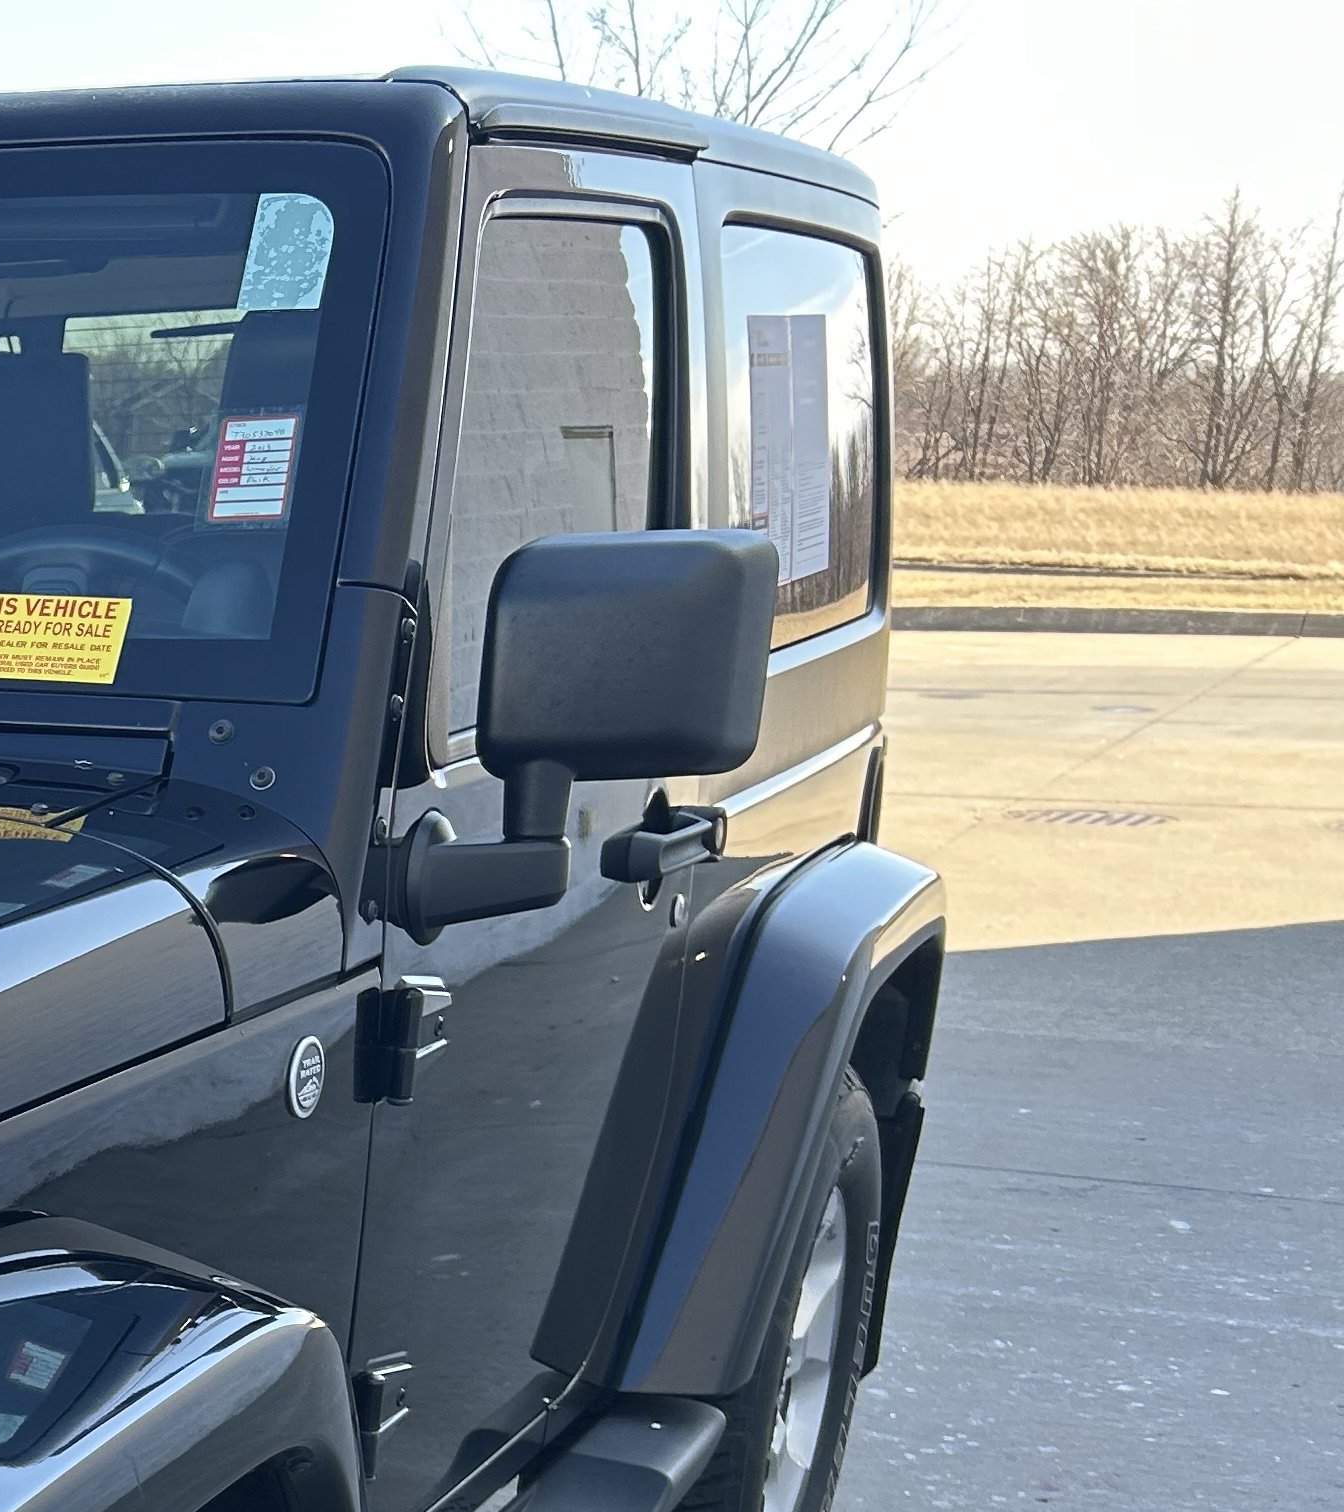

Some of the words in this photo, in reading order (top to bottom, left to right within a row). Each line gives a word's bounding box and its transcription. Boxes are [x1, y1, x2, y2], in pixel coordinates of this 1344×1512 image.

[26, 598, 120, 619] VEHICLE
[44, 621, 73, 637] FOR
[75, 623, 113, 638] SALE
[30, 641, 48, 649] FOR
[52, 642, 86, 651] RESALE
[90, 644, 112, 652] DATE
